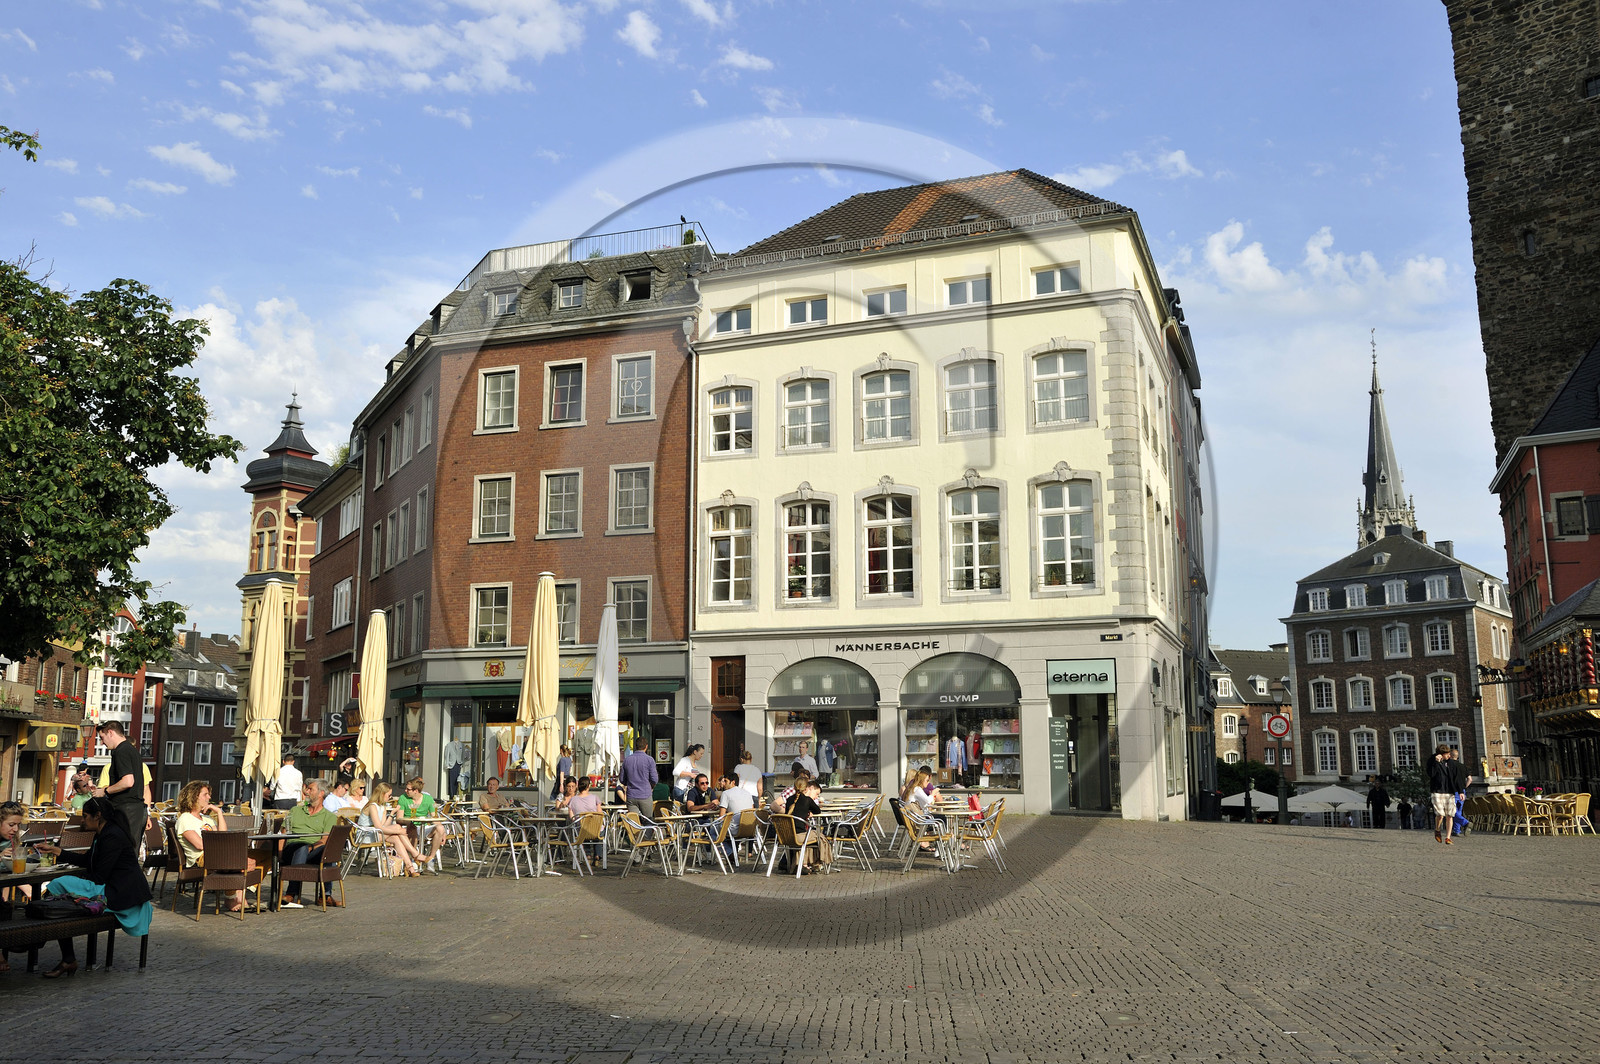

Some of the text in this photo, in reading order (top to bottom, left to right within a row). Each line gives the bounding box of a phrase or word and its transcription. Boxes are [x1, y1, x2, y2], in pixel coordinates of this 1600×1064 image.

[835, 641, 940, 652] MÄNNERSACHE
[1052, 671, 1109, 683] eterna
[939, 694, 979, 703] OLYMP
